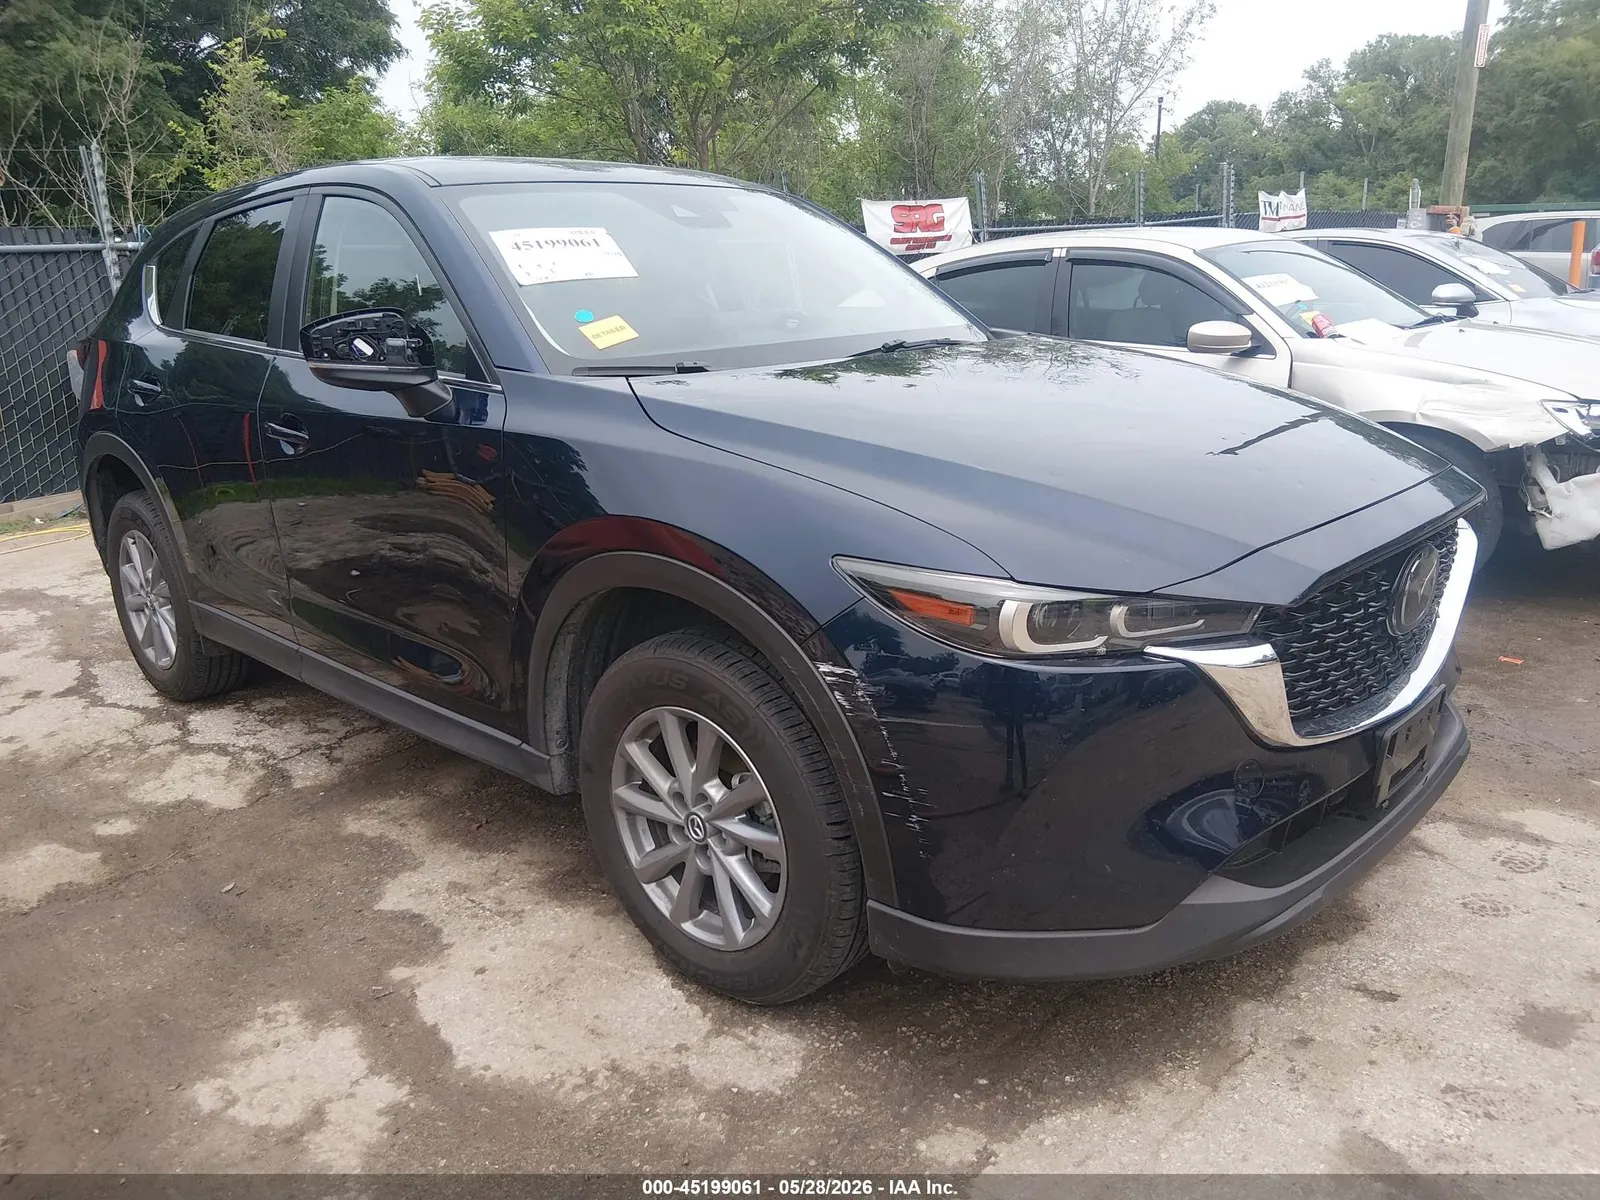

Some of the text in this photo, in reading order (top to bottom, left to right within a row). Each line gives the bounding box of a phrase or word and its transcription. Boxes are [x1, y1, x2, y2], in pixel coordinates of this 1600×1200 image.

[891, 203, 945, 233] SRG
[511, 238, 601, 251] 45199061
[591, 325, 626, 340] DETAILED
